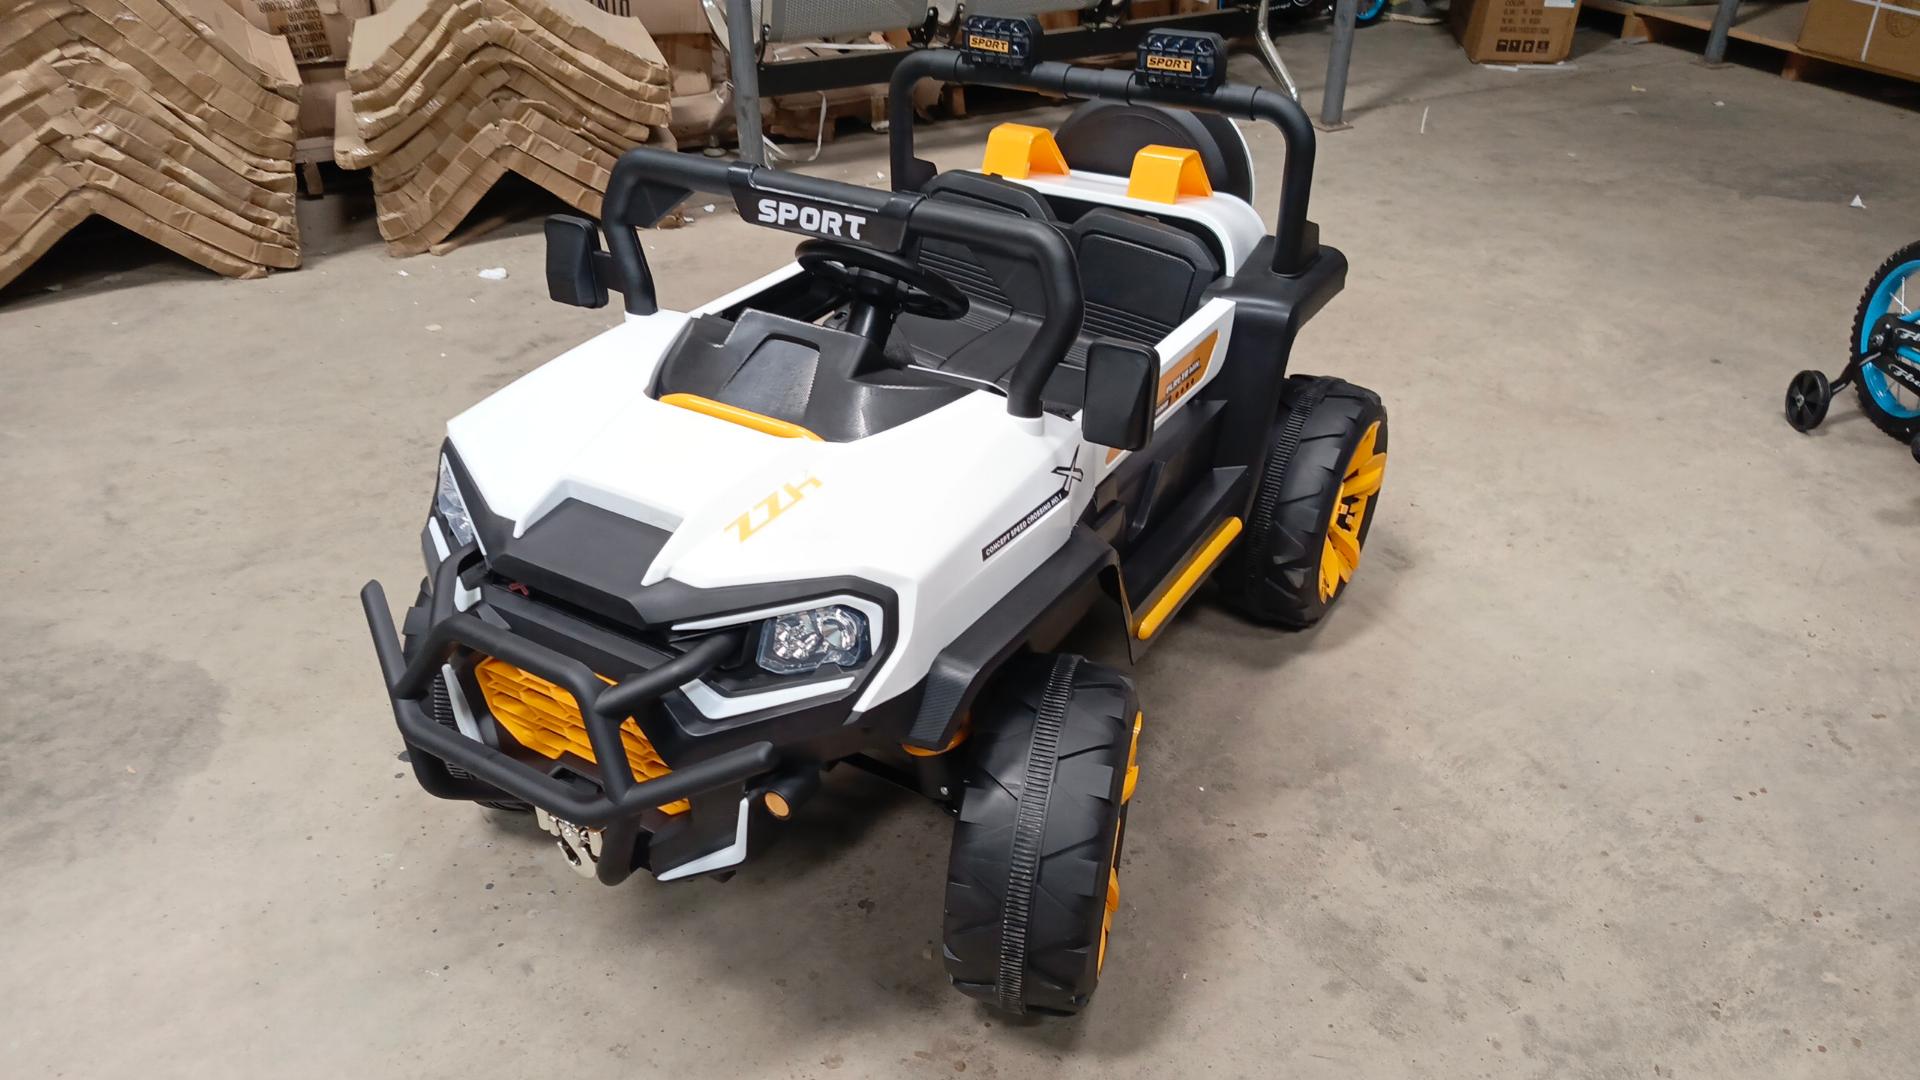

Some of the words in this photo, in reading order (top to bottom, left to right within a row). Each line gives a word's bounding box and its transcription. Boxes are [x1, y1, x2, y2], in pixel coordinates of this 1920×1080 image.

[971, 36, 1007, 50] SPORT
[1149, 57, 1190, 69] SPORT
[758, 198, 867, 241] SPORT
[985, 532, 1011, 556] CONCEPT
[1010, 520, 1027, 537] SPEED
[1026, 501, 1053, 525] CROSSING
[1050, 493, 1063, 506] NO.1
